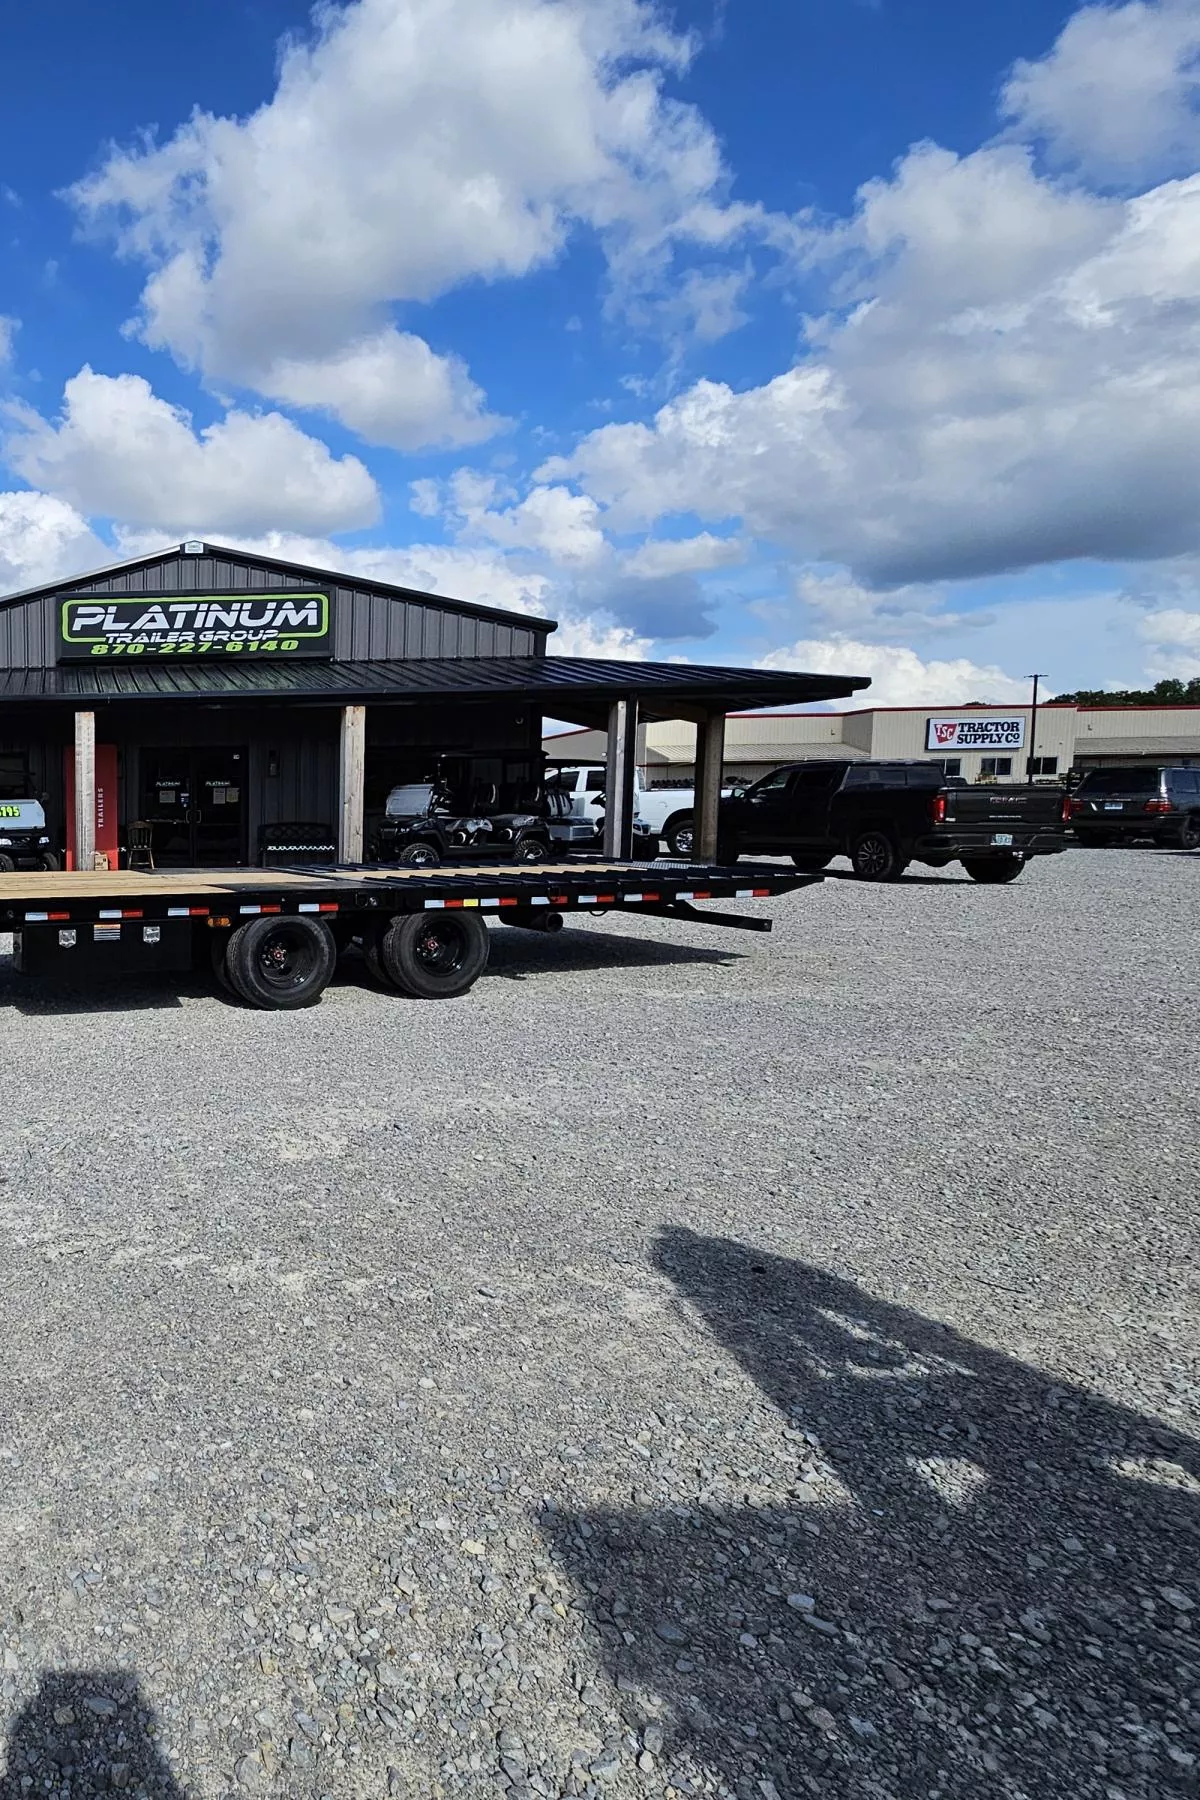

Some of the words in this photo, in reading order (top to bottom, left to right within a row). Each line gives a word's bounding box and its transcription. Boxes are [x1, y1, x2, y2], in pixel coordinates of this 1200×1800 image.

[72, 600, 318, 631] PLATINUM
[105, 632, 195, 644] TRAILER
[198, 629, 280, 642] GROUP
[90, 640, 299, 655] 870-227-6140
[935, 724, 954, 740] TSC
[958, 721, 1020, 733] TRACTOR
[957, 733, 1004, 744] SUPPLY
